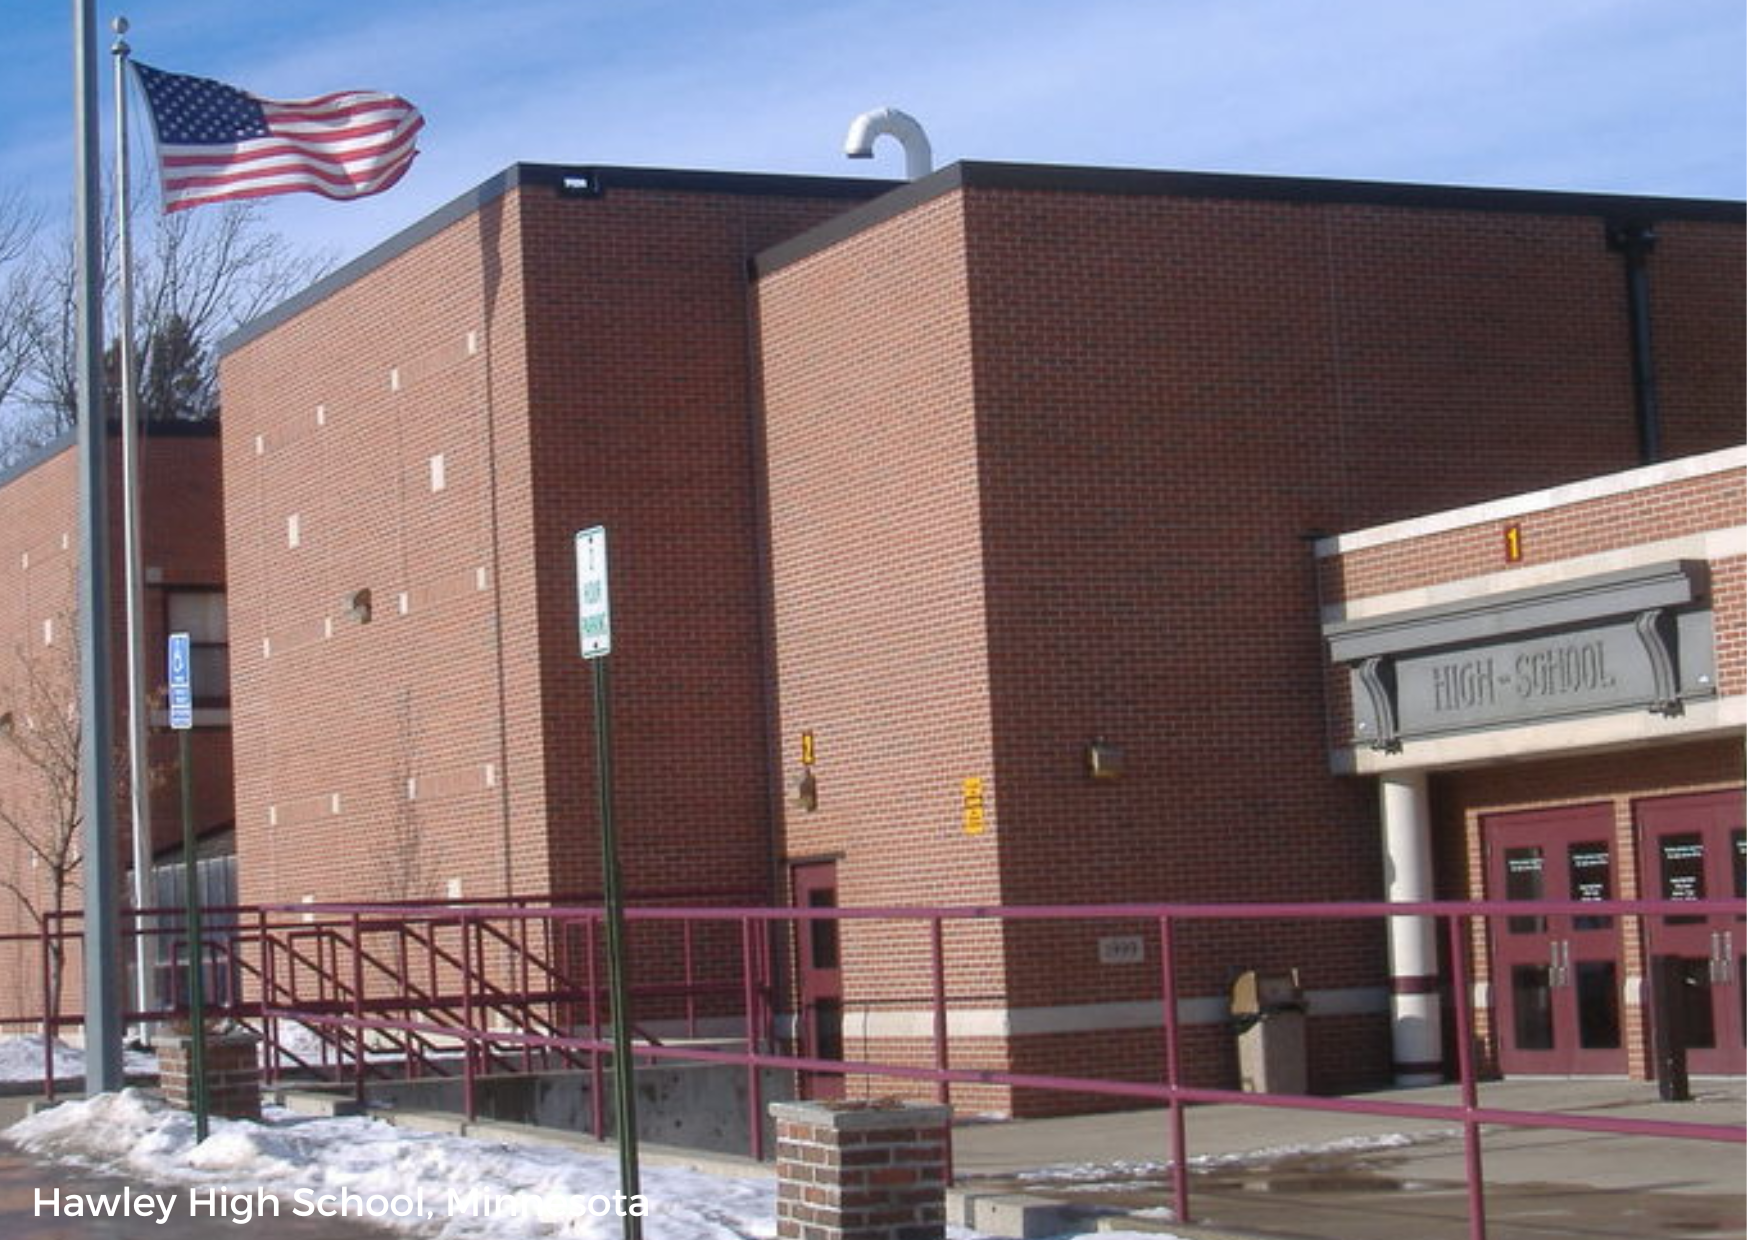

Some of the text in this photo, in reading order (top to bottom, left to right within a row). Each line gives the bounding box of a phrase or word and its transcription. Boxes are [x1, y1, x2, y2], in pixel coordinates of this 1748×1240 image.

[1507, 527, 1519, 560] 1
[1433, 658, 1494, 711] HIGH
[1515, 641, 1616, 698] SCHOOL
